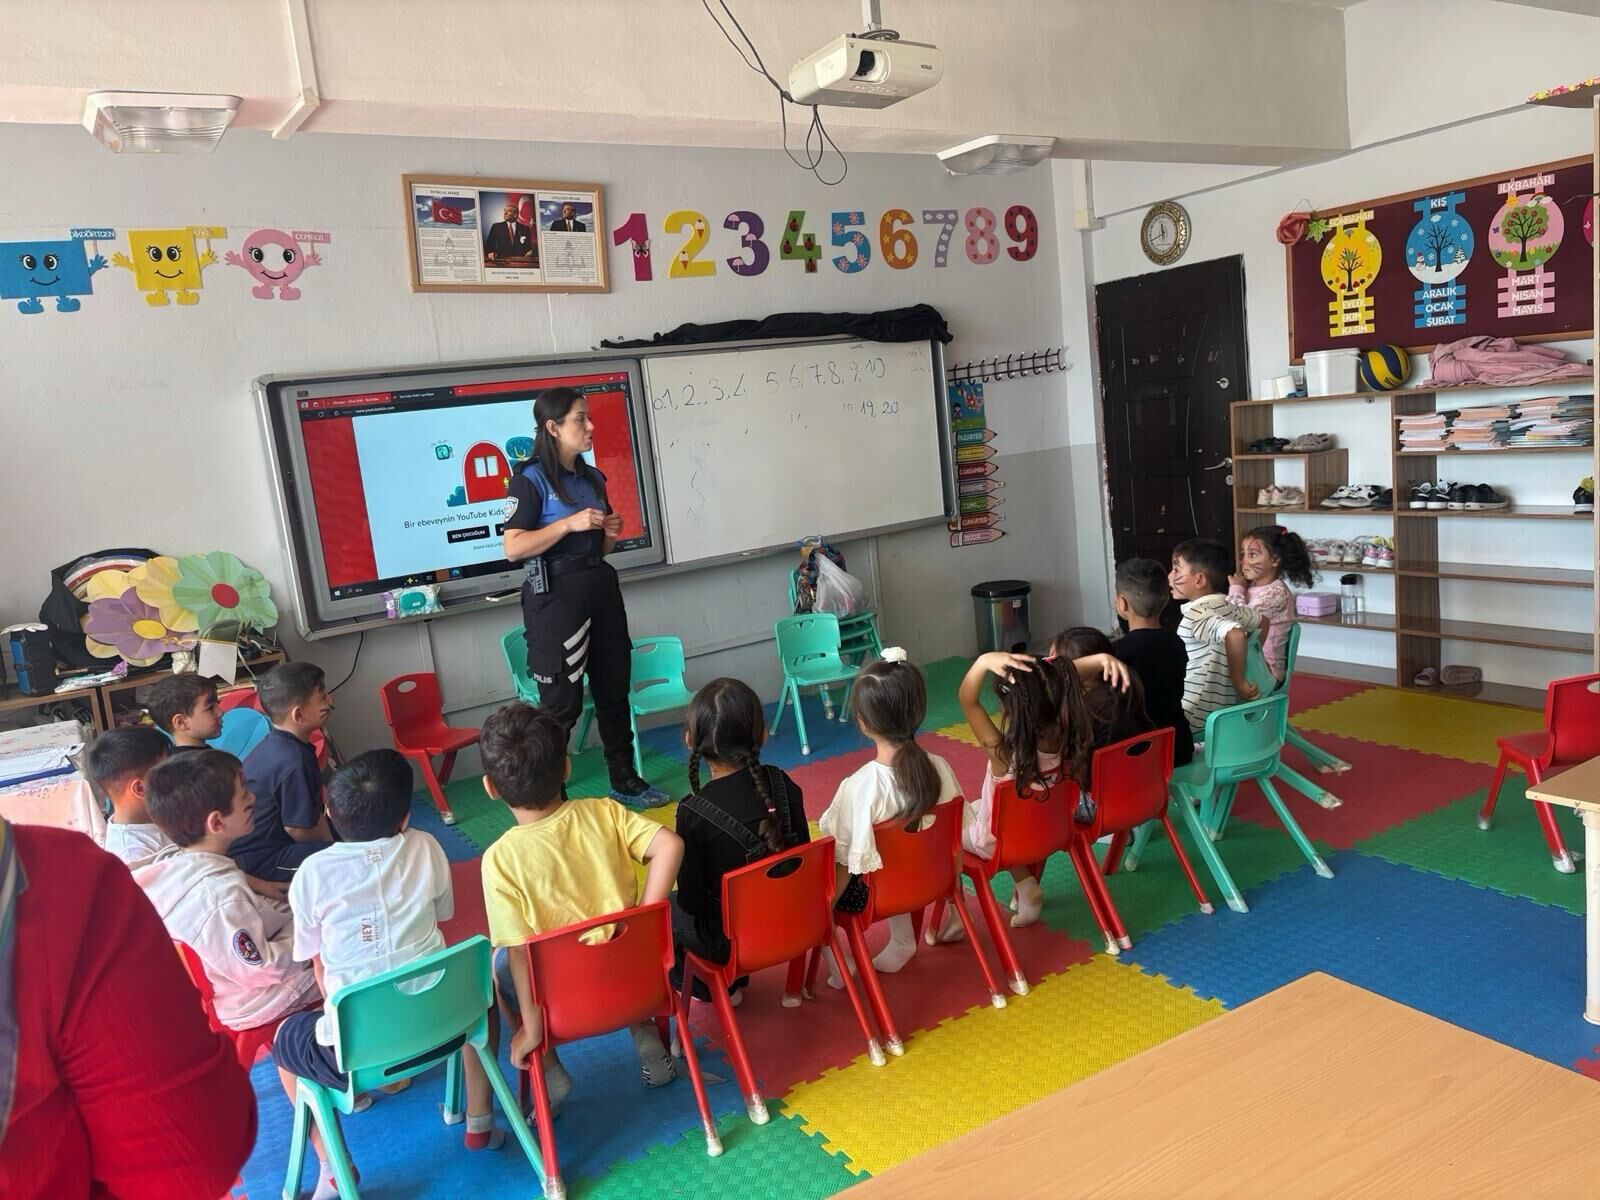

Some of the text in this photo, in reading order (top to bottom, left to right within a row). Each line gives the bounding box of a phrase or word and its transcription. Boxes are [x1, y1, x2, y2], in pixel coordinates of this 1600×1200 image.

[613, 213, 653, 281] 1
[663, 209, 716, 279] 2
[723, 210, 770, 277] 3
[780, 211, 822, 273] 4
[831, 211, 871, 274] 5
[879, 208, 919, 270] 6
[922, 210, 959, 268] 7
[964, 207, 1000, 265] 8
[1004, 205, 1039, 262] 9
[1511, 274, 1541, 286] MART
[1422, 287, 1457, 300] ARALIK
[1425, 301, 1455, 313] OCAK
[1512, 304, 1543, 315] MAYIS
[1426, 315, 1456, 327] ŞUBAT
[404, 521, 416, 529] Bir
[417, 515, 455, 527] ebeveynin
[456, 512, 487, 521] YouTube
